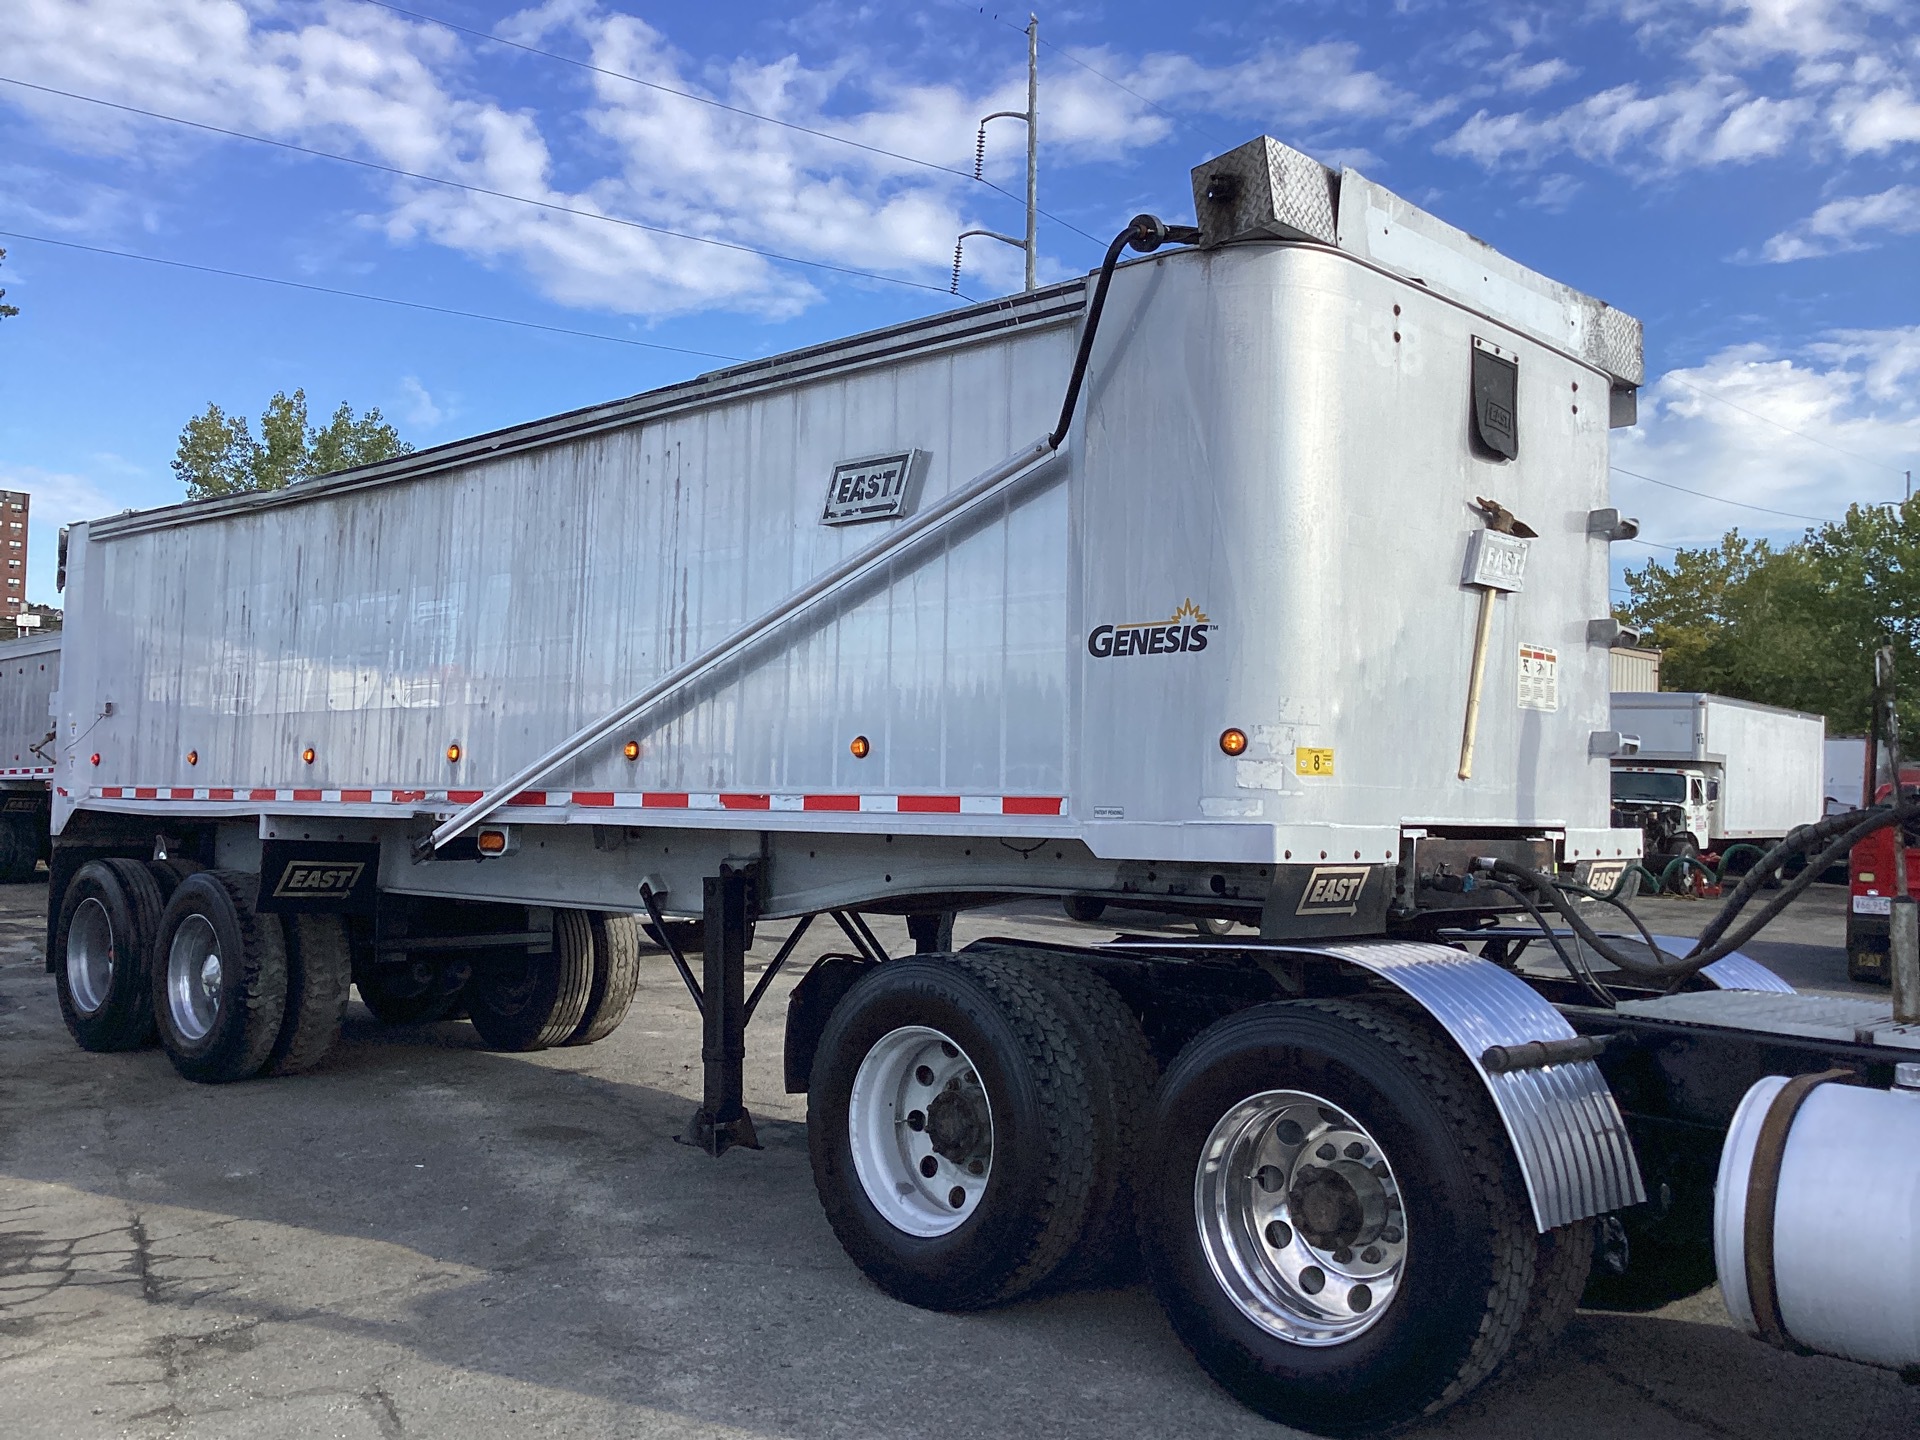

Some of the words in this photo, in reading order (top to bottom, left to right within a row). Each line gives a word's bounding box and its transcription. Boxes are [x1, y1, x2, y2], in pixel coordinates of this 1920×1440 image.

[836, 470, 897, 504] EAST
[1484, 546, 1522, 576] EAST
[1088, 624, 1208, 658] GENESIS
[1314, 755, 1320, 771] 8
[288, 870, 353, 888] EAST
[1309, 878, 1361, 902] EAST
[1590, 871, 1620, 890] EAST
